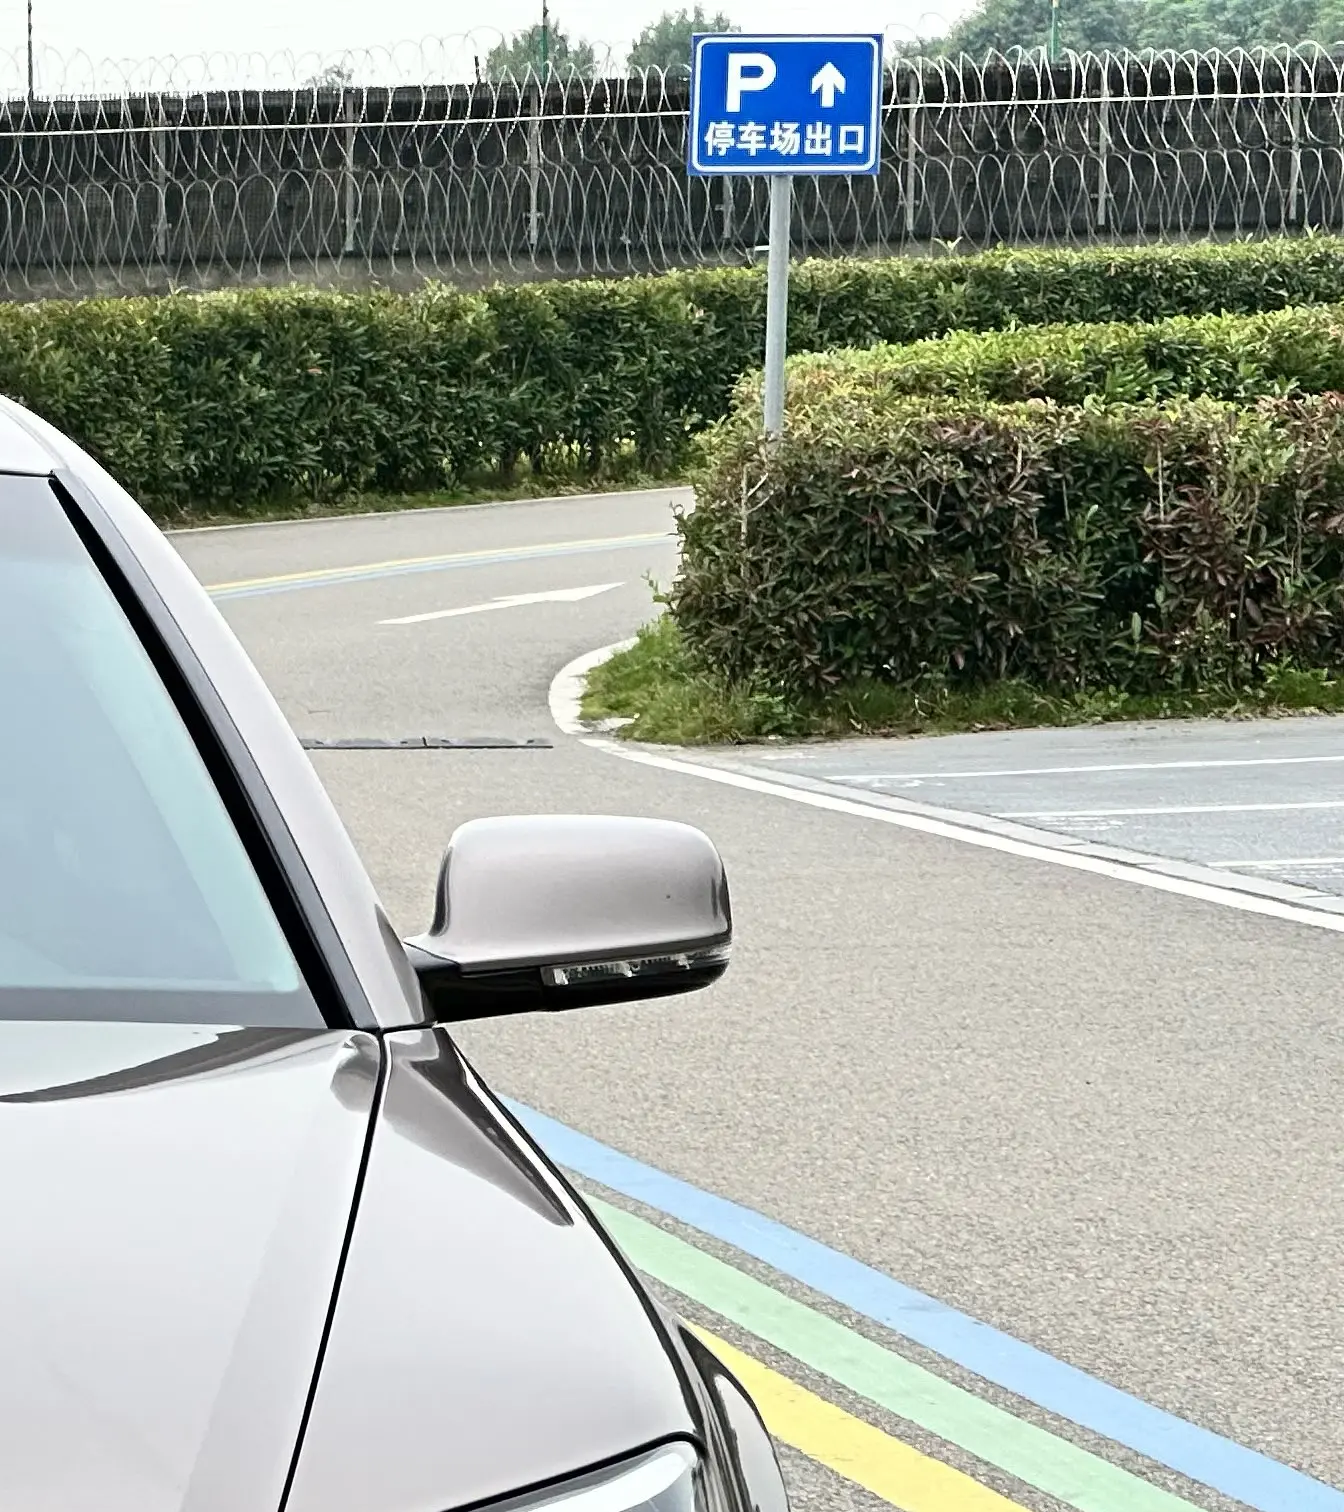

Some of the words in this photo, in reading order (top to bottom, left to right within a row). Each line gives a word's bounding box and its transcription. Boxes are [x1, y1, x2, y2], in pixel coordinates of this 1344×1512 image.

[726, 53, 777, 112] P
[704, 121, 864, 157] 停车场出口
